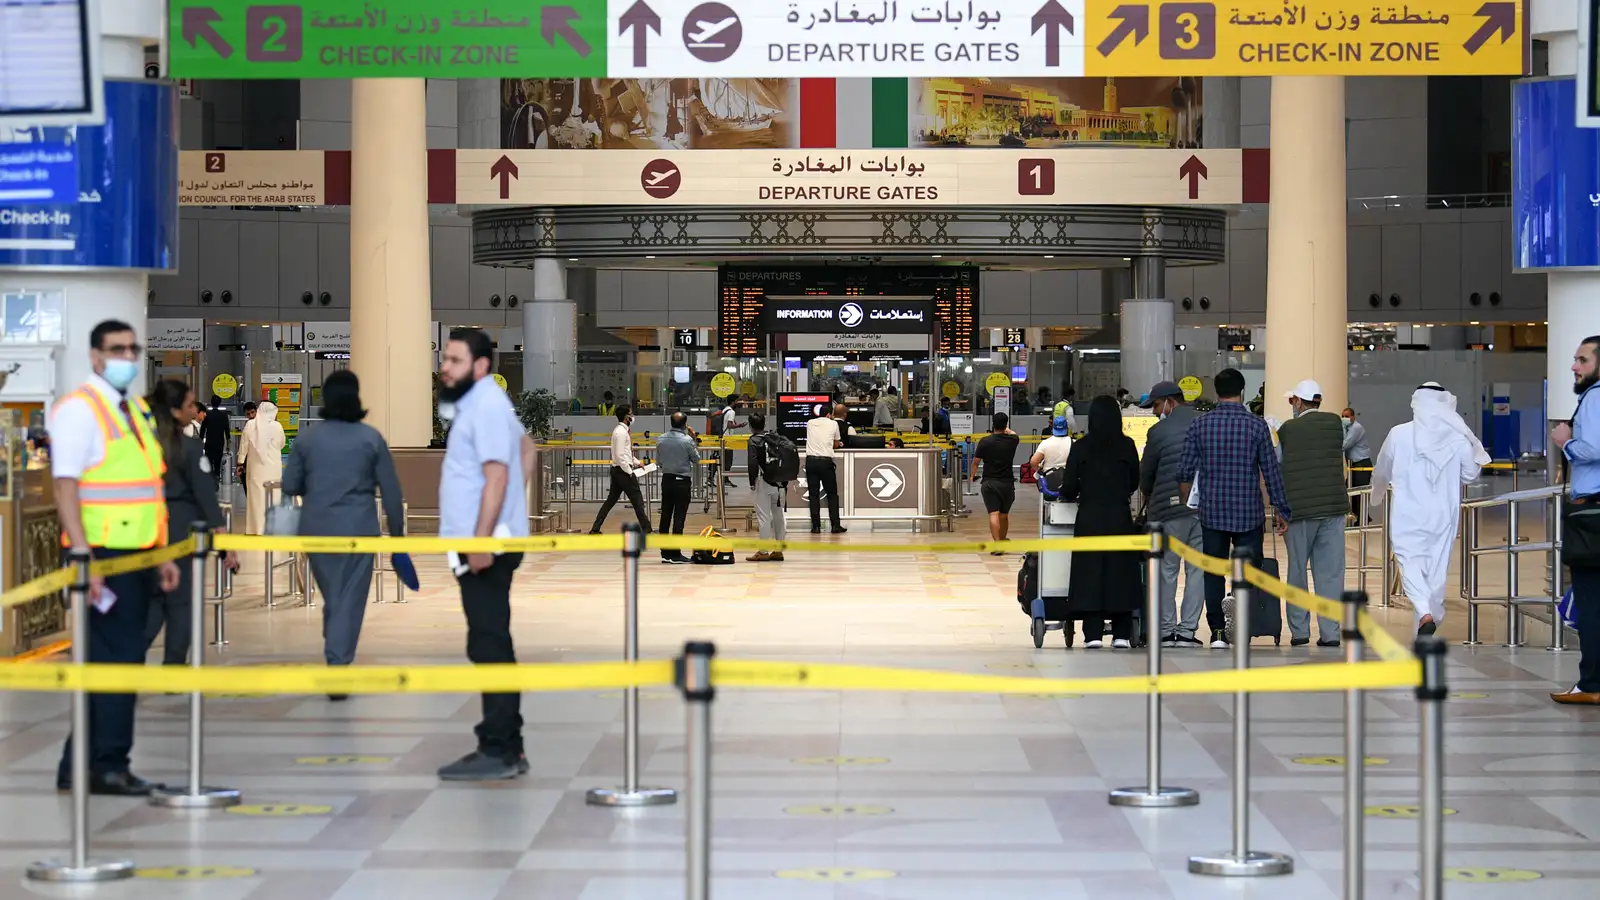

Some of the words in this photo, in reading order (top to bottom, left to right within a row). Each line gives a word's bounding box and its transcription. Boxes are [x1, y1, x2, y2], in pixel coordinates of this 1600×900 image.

[309, 2, 387, 29] الأمتعة
[395, 13, 441, 34] وزن
[451, 7, 530, 28] منطقة
[786, 0, 897, 30] المغادرة
[911, 0, 1001, 30] بوابات
[1228, 0, 1306, 26] الأمتعة
[1314, 11, 1361, 31] وزن
[1369, 5, 1450, 26] منطقة
[261, 16, 288, 52] 2
[1175, 13, 1200, 50] 3
[319, 44, 442, 66] CHECK-IN
[449, 44, 520, 65] ZONE
[767, 42, 926, 63] DEPARTURE
[933, 41, 1021, 63] GATES
[1238, 42, 1362, 62] CHECK-IN
[1369, 41, 1440, 62] ZONE
[210, 156, 221, 170] 2
[771, 155, 852, 177] المغادرة
[859, 155, 926, 177] بوابات
[211, 180, 244, 191] التعاون
[246, 180, 278, 191] مجلس
[281, 180, 314, 190] مواطنو
[1029, 165, 1043, 189] 1
[194, 195, 229, 203] COUNCIL
[230, 195, 246, 203] FOR
[247, 195, 262, 203] THE
[264, 195, 286, 203] ARAB
[287, 195, 316, 203] STATES
[758, 186, 872, 200] DEPARTURE
[876, 186, 938, 200] GATES
[1, 208, 71, 225] Check-In
[738, 271, 802, 281] DEPARTURES
[776, 309, 833, 319] INFORMATION
[680, 335, 692, 345] 10
[1007, 334, 1021, 344] 28
